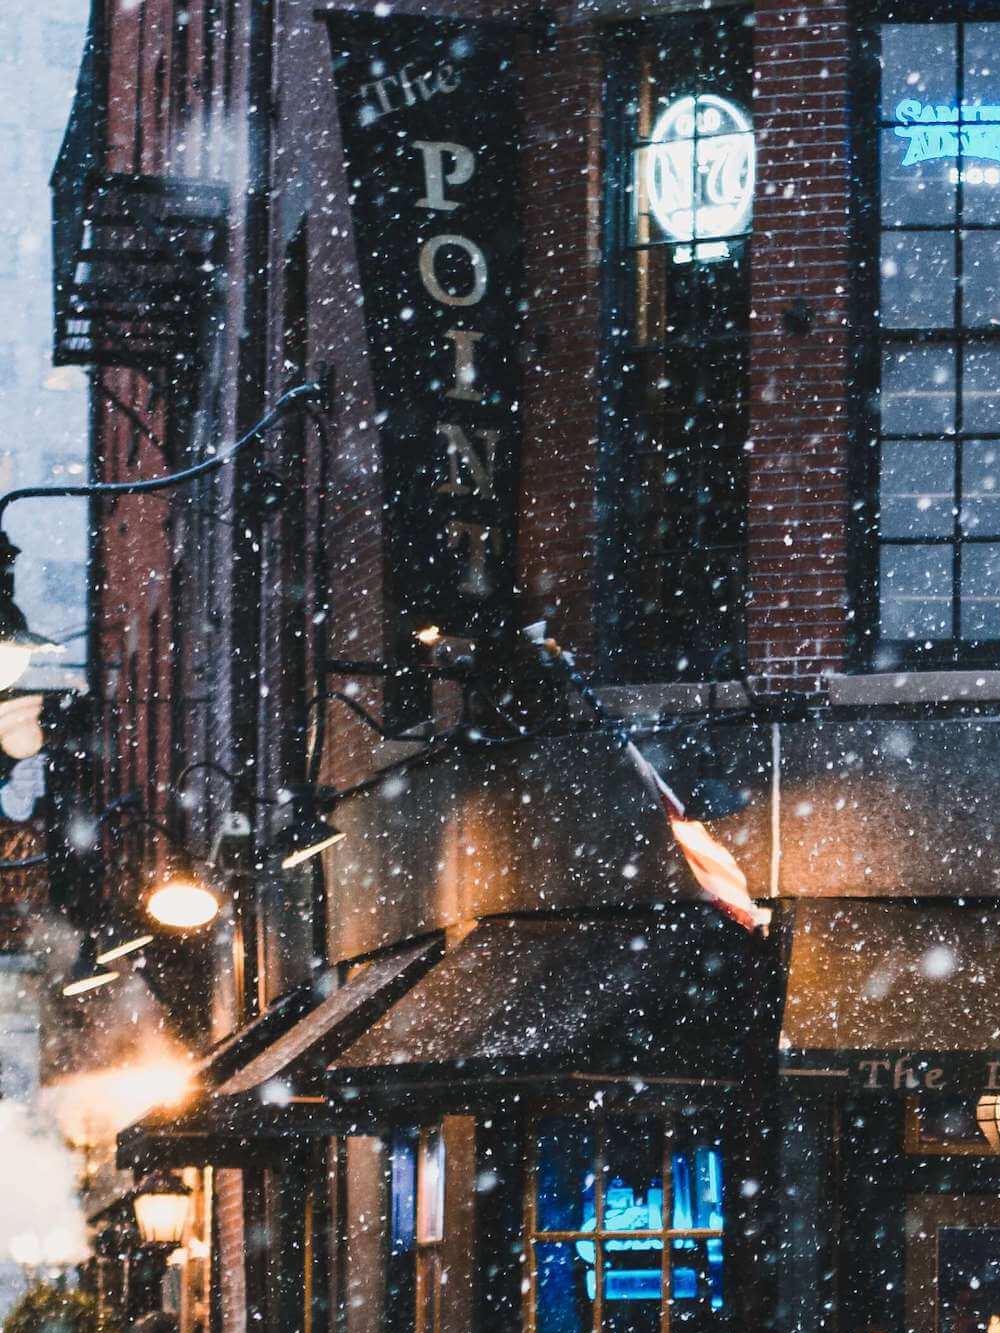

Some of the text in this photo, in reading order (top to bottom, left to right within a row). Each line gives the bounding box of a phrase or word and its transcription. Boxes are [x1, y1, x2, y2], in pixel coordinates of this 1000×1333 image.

[358, 61, 462, 117] The
[411, 140, 503, 595] POINT
[858, 1056, 948, 1089] The
